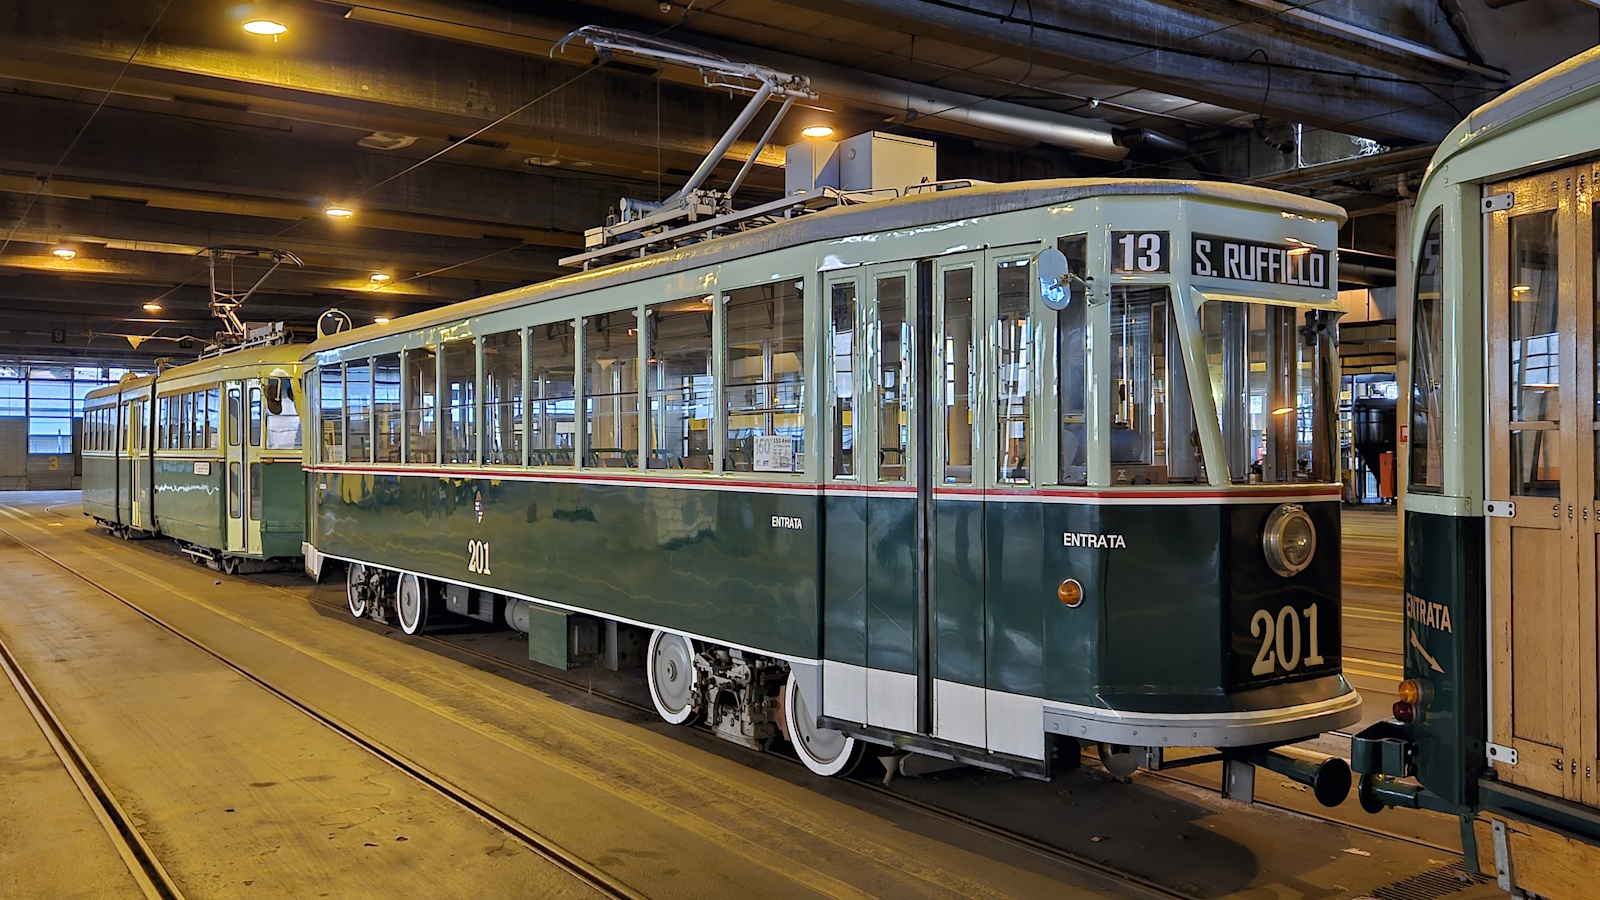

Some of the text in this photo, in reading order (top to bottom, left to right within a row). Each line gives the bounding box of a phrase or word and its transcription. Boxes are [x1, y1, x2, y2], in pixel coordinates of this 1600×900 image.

[1118, 233, 1161, 272] 13
[1195, 239, 1324, 288] S. RUFFILLO
[334, 317, 344, 334] 7
[48, 455, 59, 471] 3
[771, 515, 803, 530] ENTRATA
[1063, 532, 1127, 549] ENTRATA
[468, 539, 491, 575] 201
[1406, 591, 1453, 634] ENTRATA
[1250, 602, 1325, 676] 201
